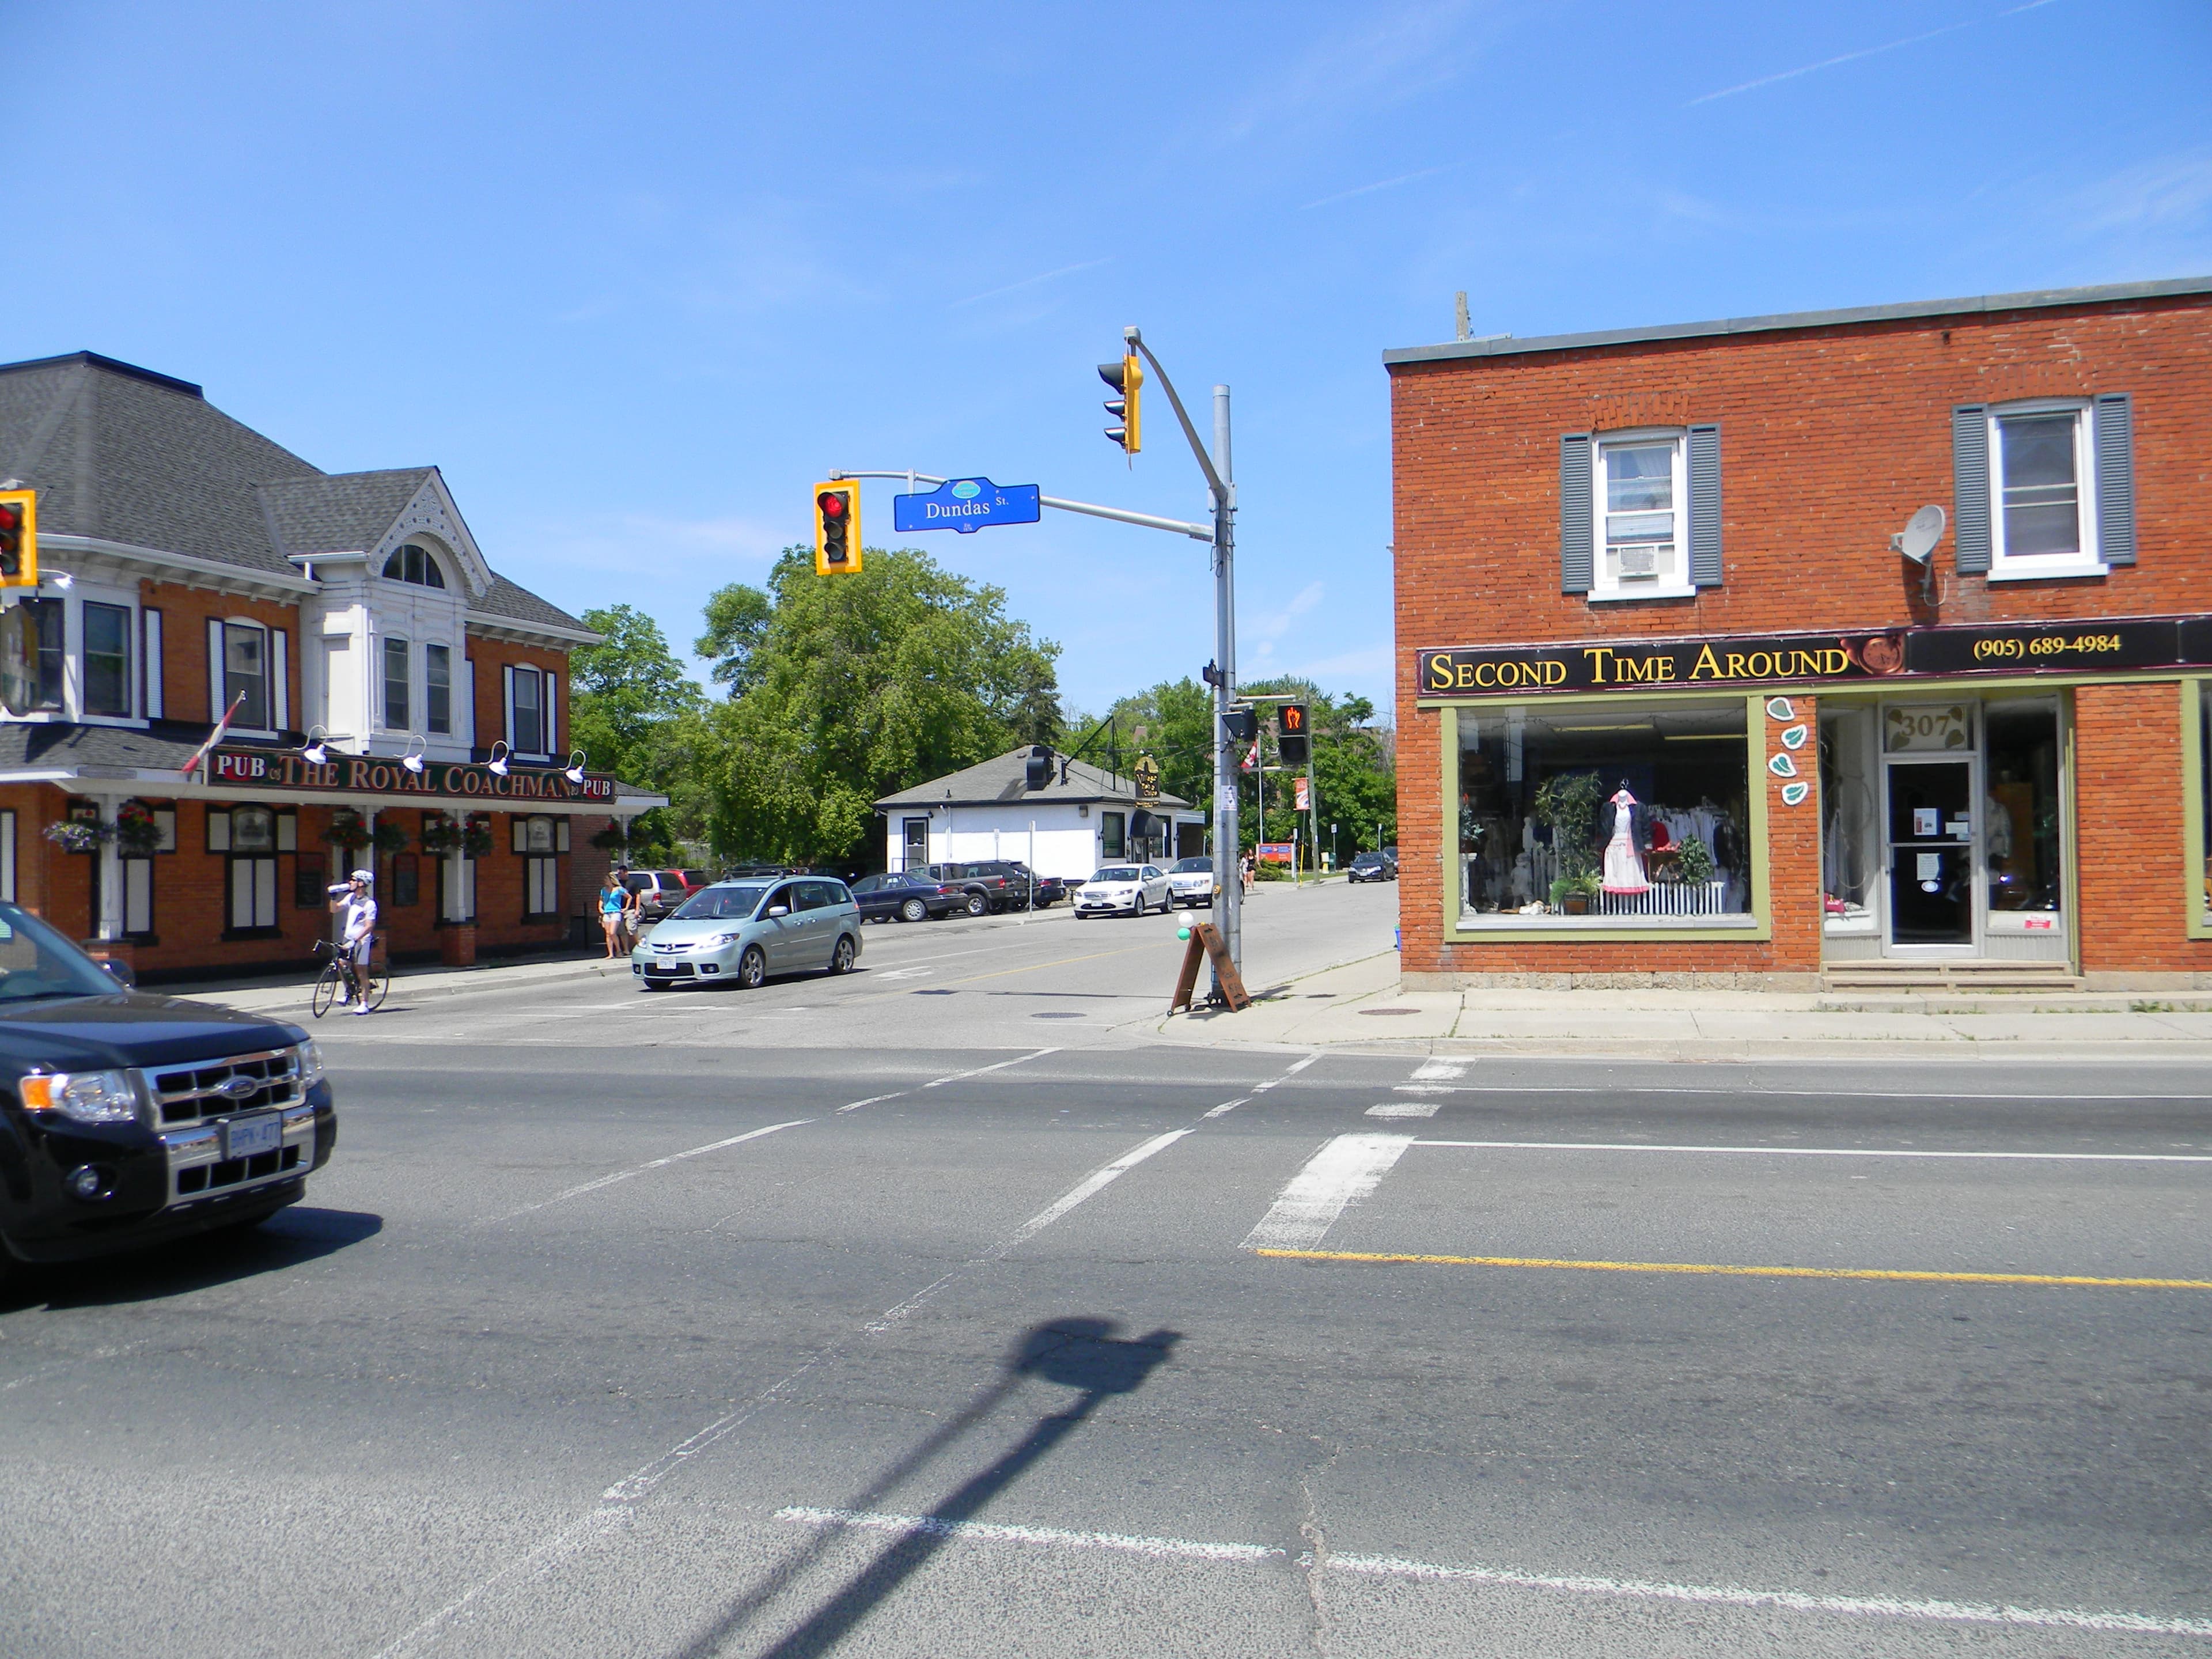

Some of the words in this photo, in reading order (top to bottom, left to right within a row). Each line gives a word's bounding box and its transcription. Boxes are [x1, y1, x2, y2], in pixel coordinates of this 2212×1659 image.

[926, 499, 991, 519] Dundas
[995, 497, 1009, 506] St.
[1973, 638, 2024, 661] (905)
[2028, 634, 2122, 655] 689-4984
[1431, 654, 1567, 690] SECOND
[1584, 648, 1676, 683] TIME
[1688, 643, 1849, 680] AROUND
[1900, 715, 1950, 737] 307
[216, 755, 266, 777] PUB
[279, 755, 339, 787] THE
[347, 760, 438, 793] ROYAL
[444, 766, 571, 800] COACHMAN
[582, 779, 611, 796] PUB
